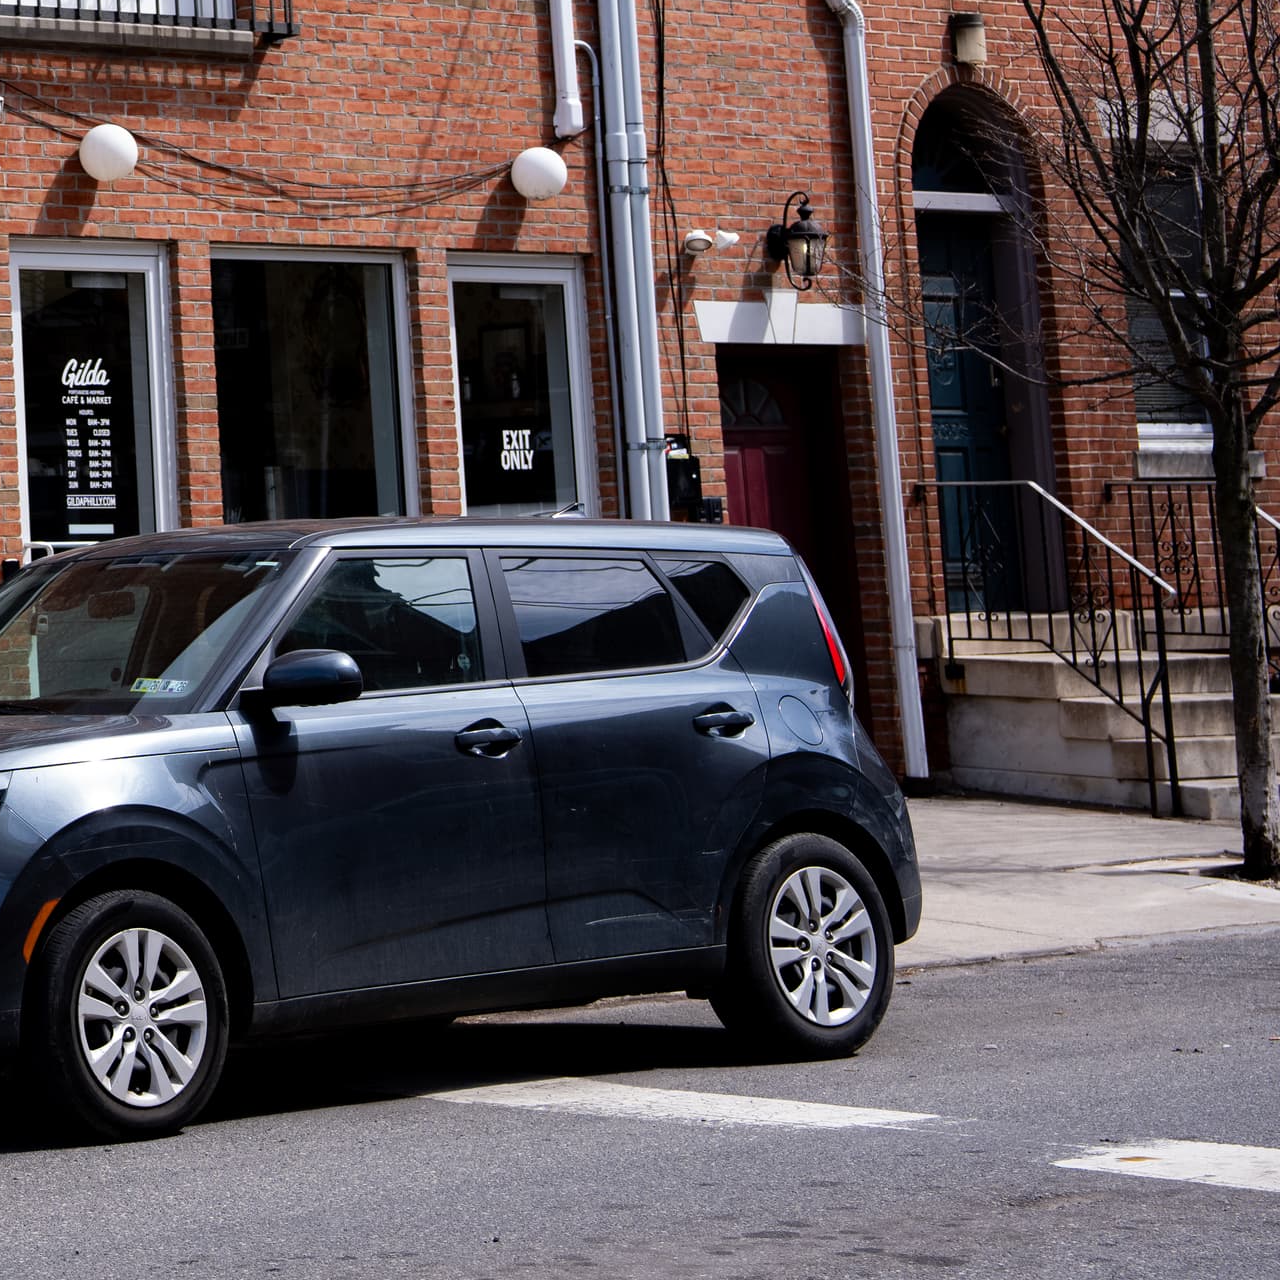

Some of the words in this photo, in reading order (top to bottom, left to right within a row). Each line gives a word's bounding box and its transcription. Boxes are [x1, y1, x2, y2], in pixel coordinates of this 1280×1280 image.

[61, 358, 110, 388] Gilda
[80, 396, 85, 404] &
[86, 396, 112, 404] MARKET
[502, 429, 531, 450] EXIT
[501, 449, 534, 470] ONLY
[66, 497, 116, 506] GILDAPHILLY.COM
